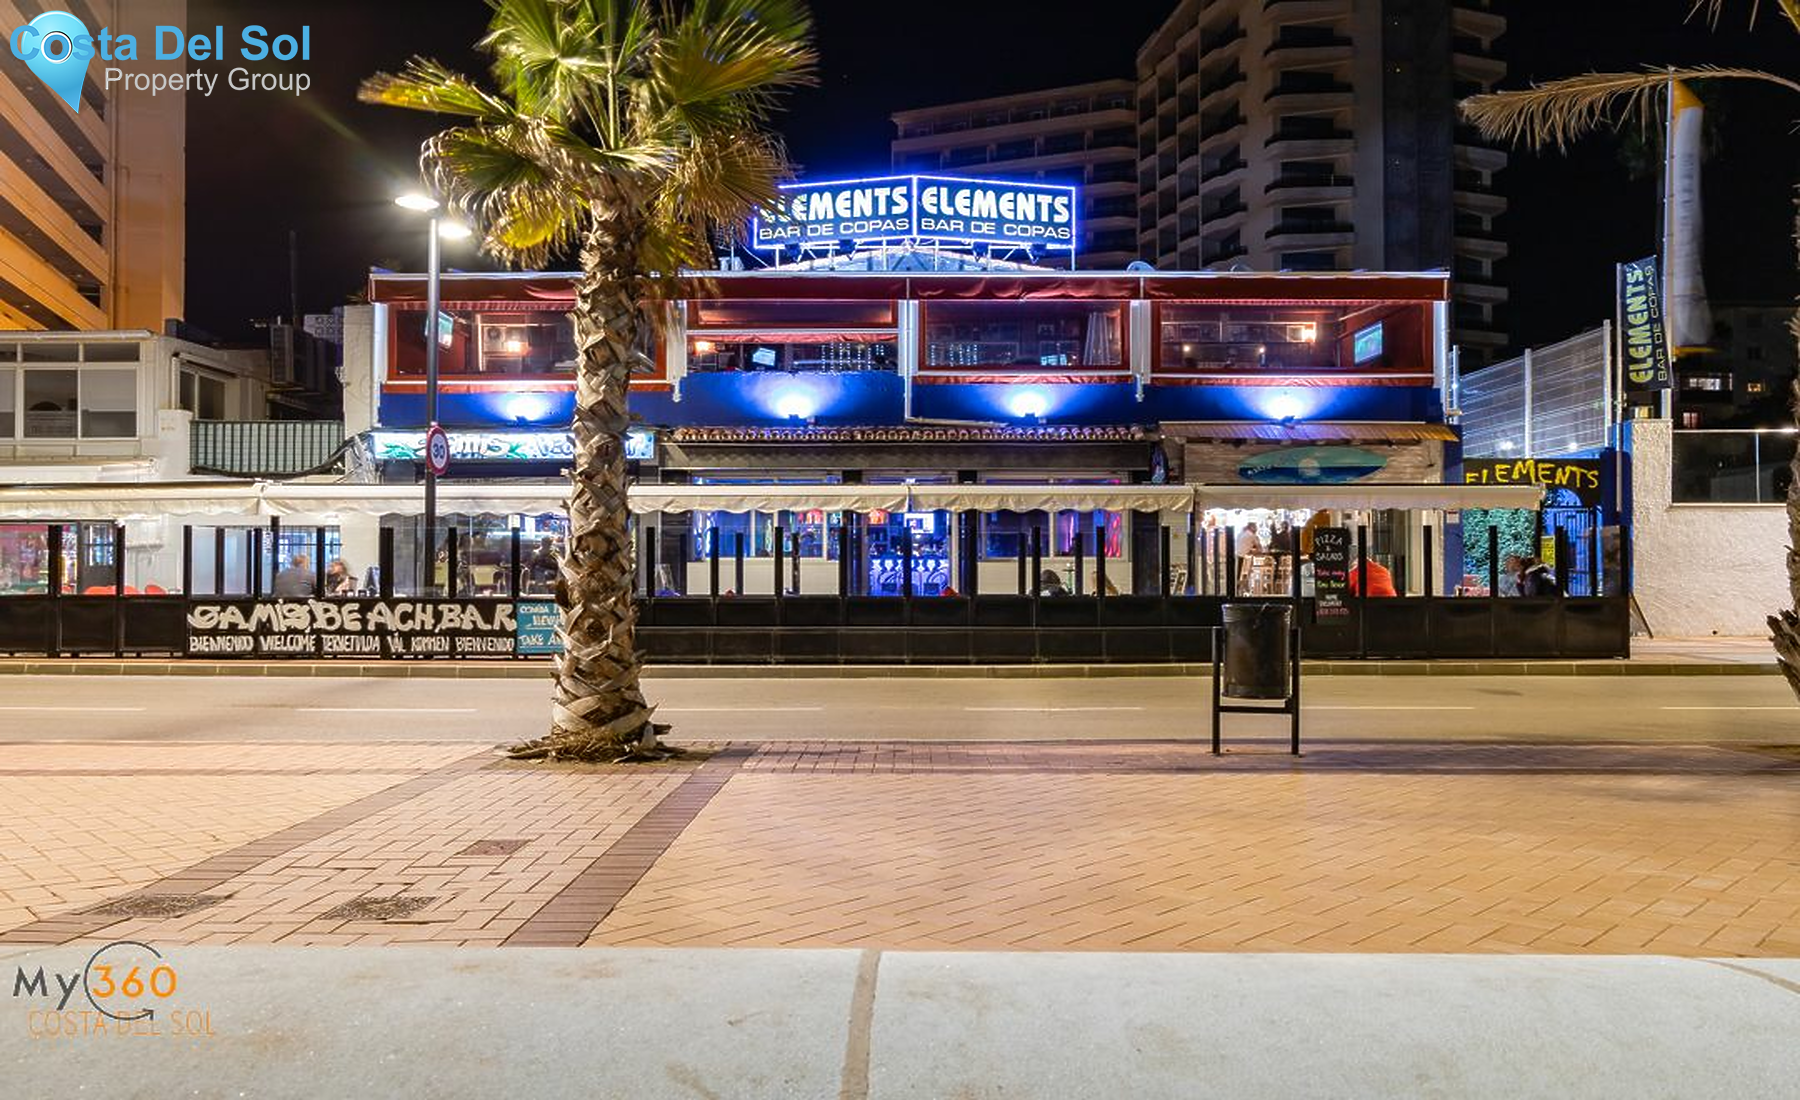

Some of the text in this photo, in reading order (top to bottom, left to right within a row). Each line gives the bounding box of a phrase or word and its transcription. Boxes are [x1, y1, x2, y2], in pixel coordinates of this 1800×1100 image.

[758, 186, 908, 224] EMENTS
[921, 186, 1070, 223] ELEMENTS
[759, 218, 909, 240] BAR DE COPAS
[921, 218, 1070, 239] BAR DE COPAS
[1626, 268, 1654, 383] ELEMENTS
[1653, 322, 1663, 344] DE
[1656, 348, 1668, 381] BAR
[432, 443, 444, 459] 30
[1315, 534, 1343, 546] PIZZA
[309, 599, 435, 632] BEACH
[434, 602, 518, 632] BAR
[260, 634, 317, 652] WELCOME
